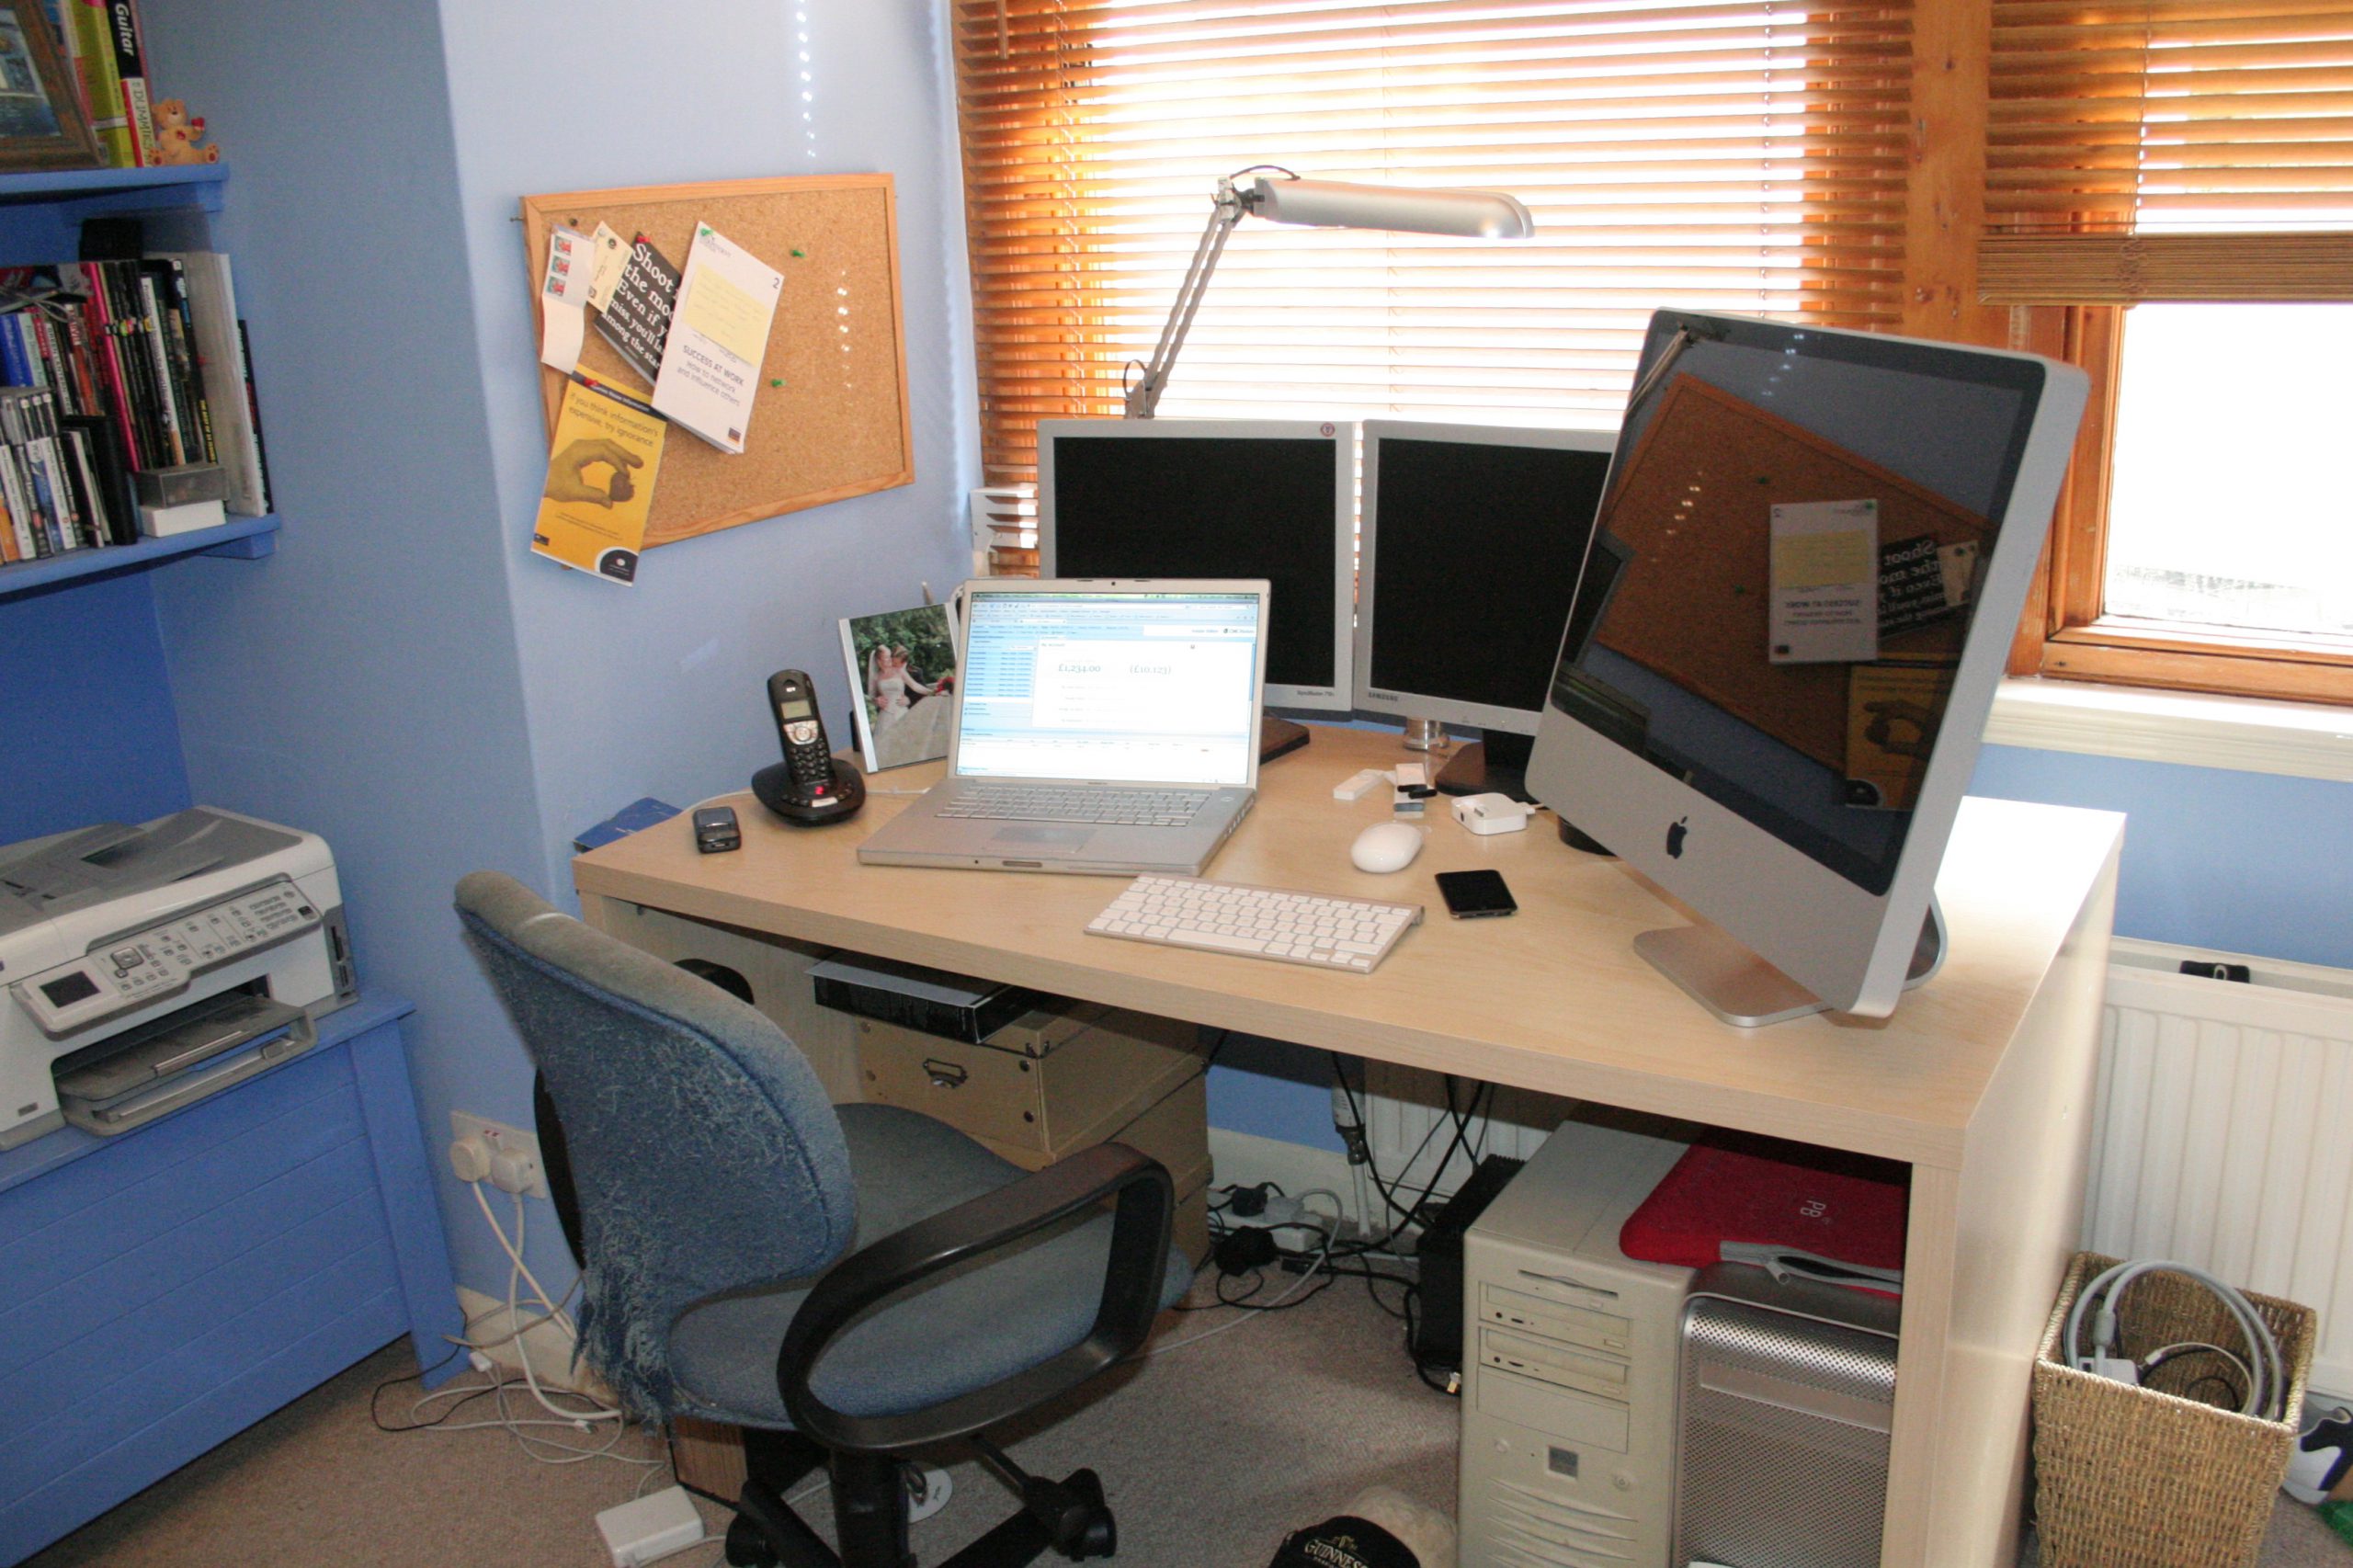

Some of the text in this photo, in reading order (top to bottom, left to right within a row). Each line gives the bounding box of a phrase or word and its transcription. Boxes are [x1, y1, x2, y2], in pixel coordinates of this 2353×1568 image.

[115, 3, 134, 57] Guitar
[625, 264, 648, 292] the
[632, 243, 674, 292] Shoot
[772, 277, 780, 290] 2
[617, 279, 645, 315] Even
[646, 310, 661, 326] if
[629, 318, 655, 345] you'll
[631, 336, 645, 354] the
[683, 345, 713, 369] SUCCESS
[713, 363, 723, 373] AT
[723, 369, 744, 386] WORK
[575, 396, 589, 409] you
[590, 402, 608, 416] think
[1058, 664, 1101, 674] £1,234.00
[1368, 691, 1399, 701] SAMSUNG
[1800, 1199, 1827, 1218] PB
